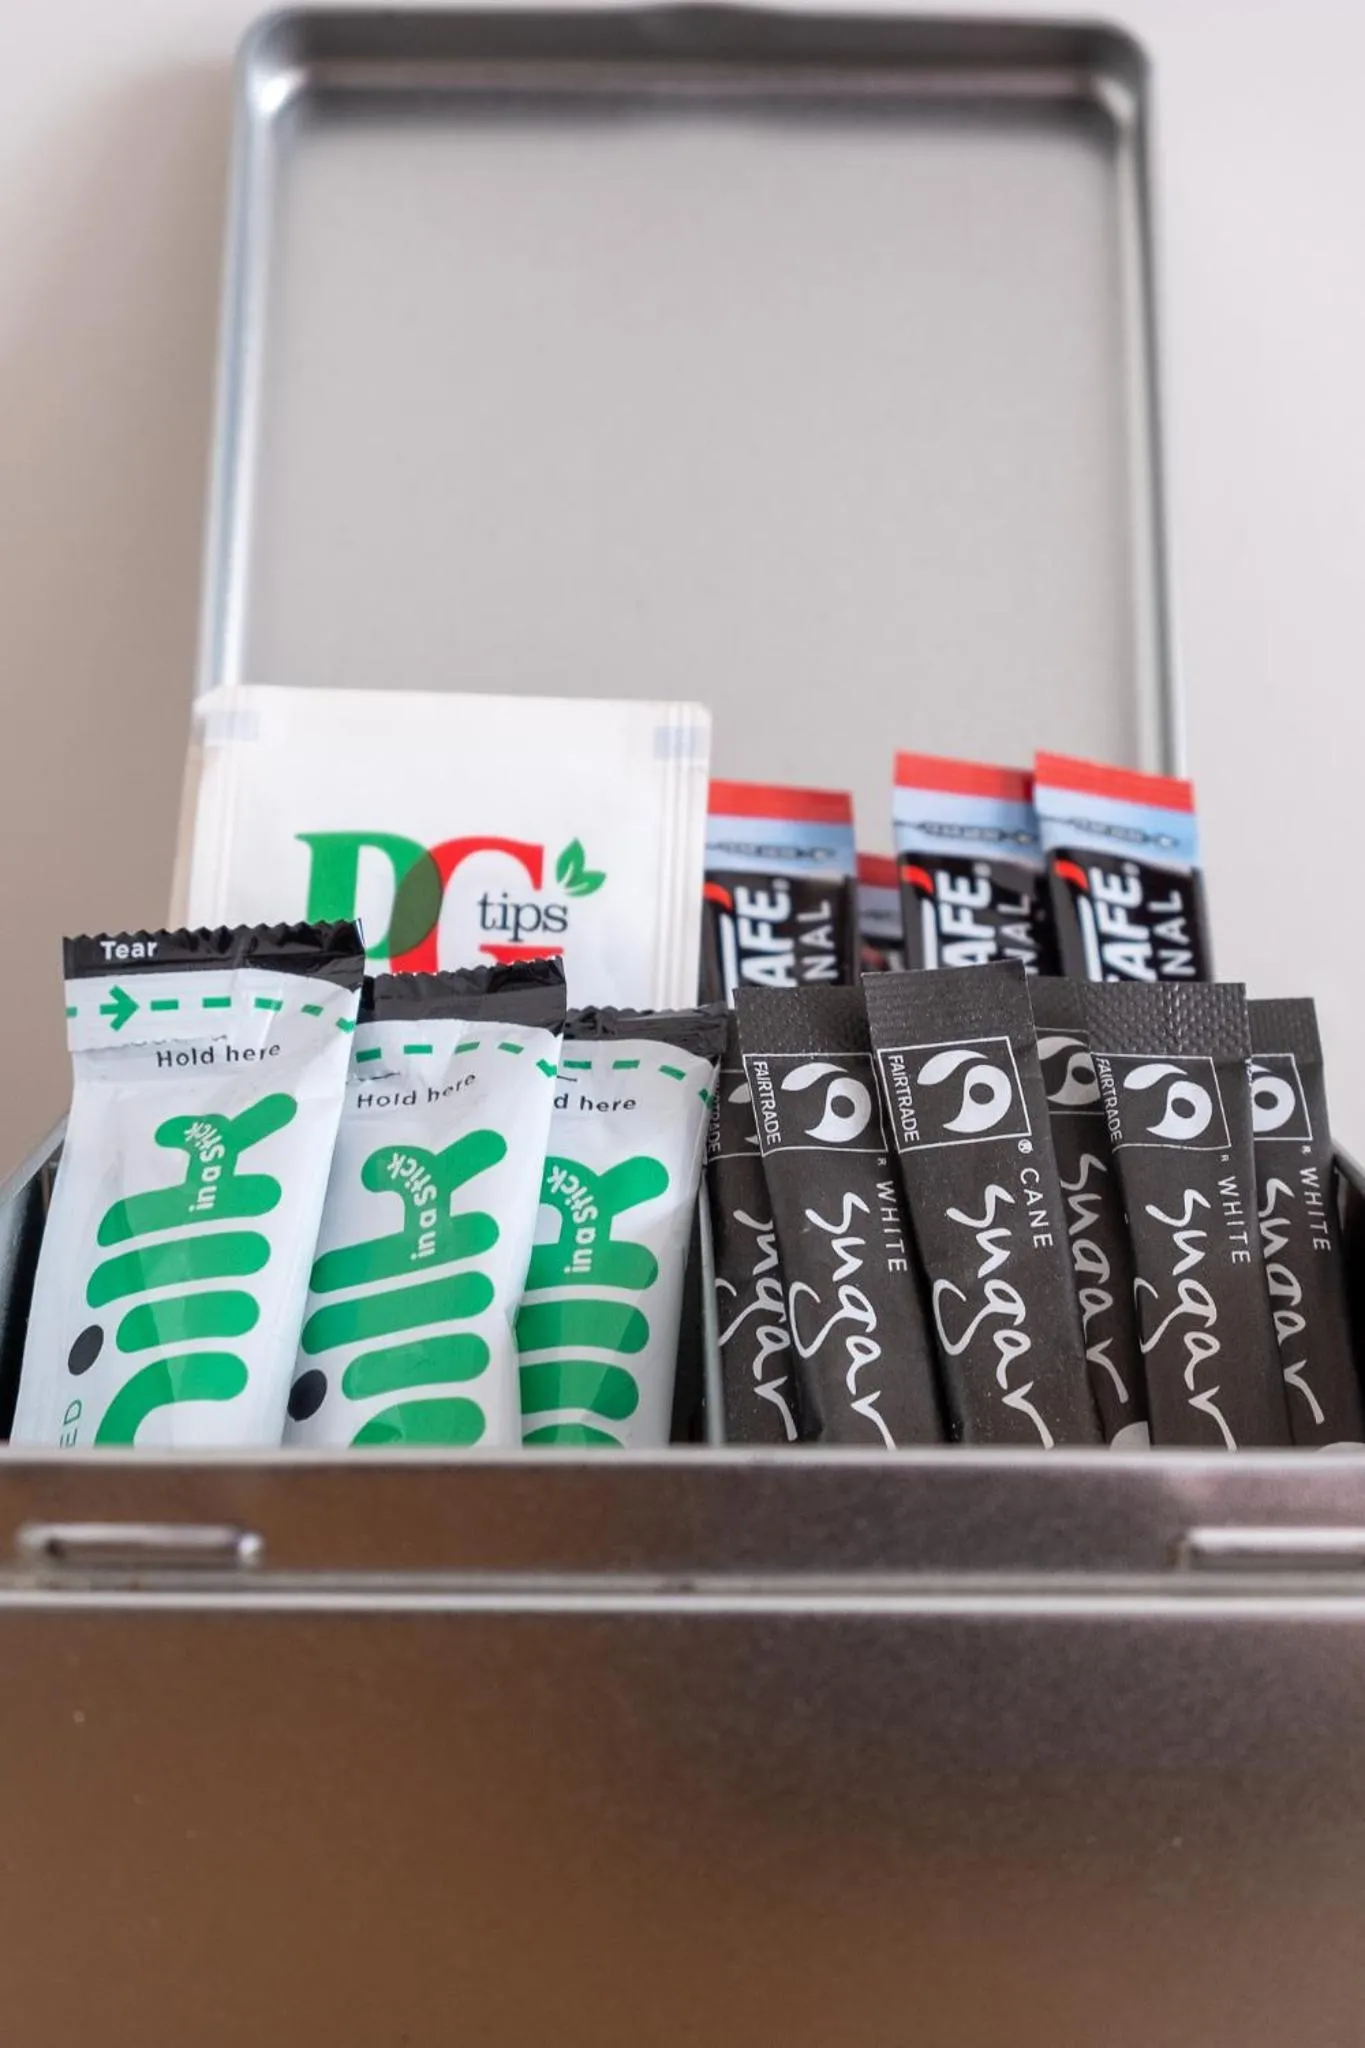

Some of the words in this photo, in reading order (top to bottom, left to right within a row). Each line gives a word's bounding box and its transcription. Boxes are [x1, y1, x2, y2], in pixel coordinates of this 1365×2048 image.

[295, 830, 565, 975] PG
[477, 893, 568, 942] tips
[796, 900, 839, 981] NAL
[1147, 890, 1196, 976] NAL
[100, 940, 158, 961] Tear
[156, 1046, 215, 1068] Hold
[226, 1043, 281, 1063] here
[357, 1090, 417, 1109] Hold
[427, 1073, 477, 1103] here
[579, 1095, 637, 1112] here
[753, 1061, 782, 1145] FAIRTRADE
[887, 1054, 921, 1143] FAIRTRADE
[1095, 1056, 1123, 1145] FAIRTRADE
[188, 1185, 218, 1213] in
[201, 1165, 222, 1182] a
[387, 1153, 438, 1207] Stick
[547, 1165, 598, 1224] Stick
[1019, 1167, 1054, 1249] CANE
[1300, 1167, 1332, 1251] WHITE
[410, 1230, 437, 1261] in
[419, 1208, 437, 1229] a
[575, 1227, 596, 1245] a
[876, 1181, 908, 1272] WHITE
[1218, 1175, 1251, 1264] WHITE
[563, 1249, 593, 1275] in
[788, 1191, 897, 1449] Sugar
[933, 1184, 1055, 1449] Sugar
[1134, 1188, 1237, 1452] Sugar
